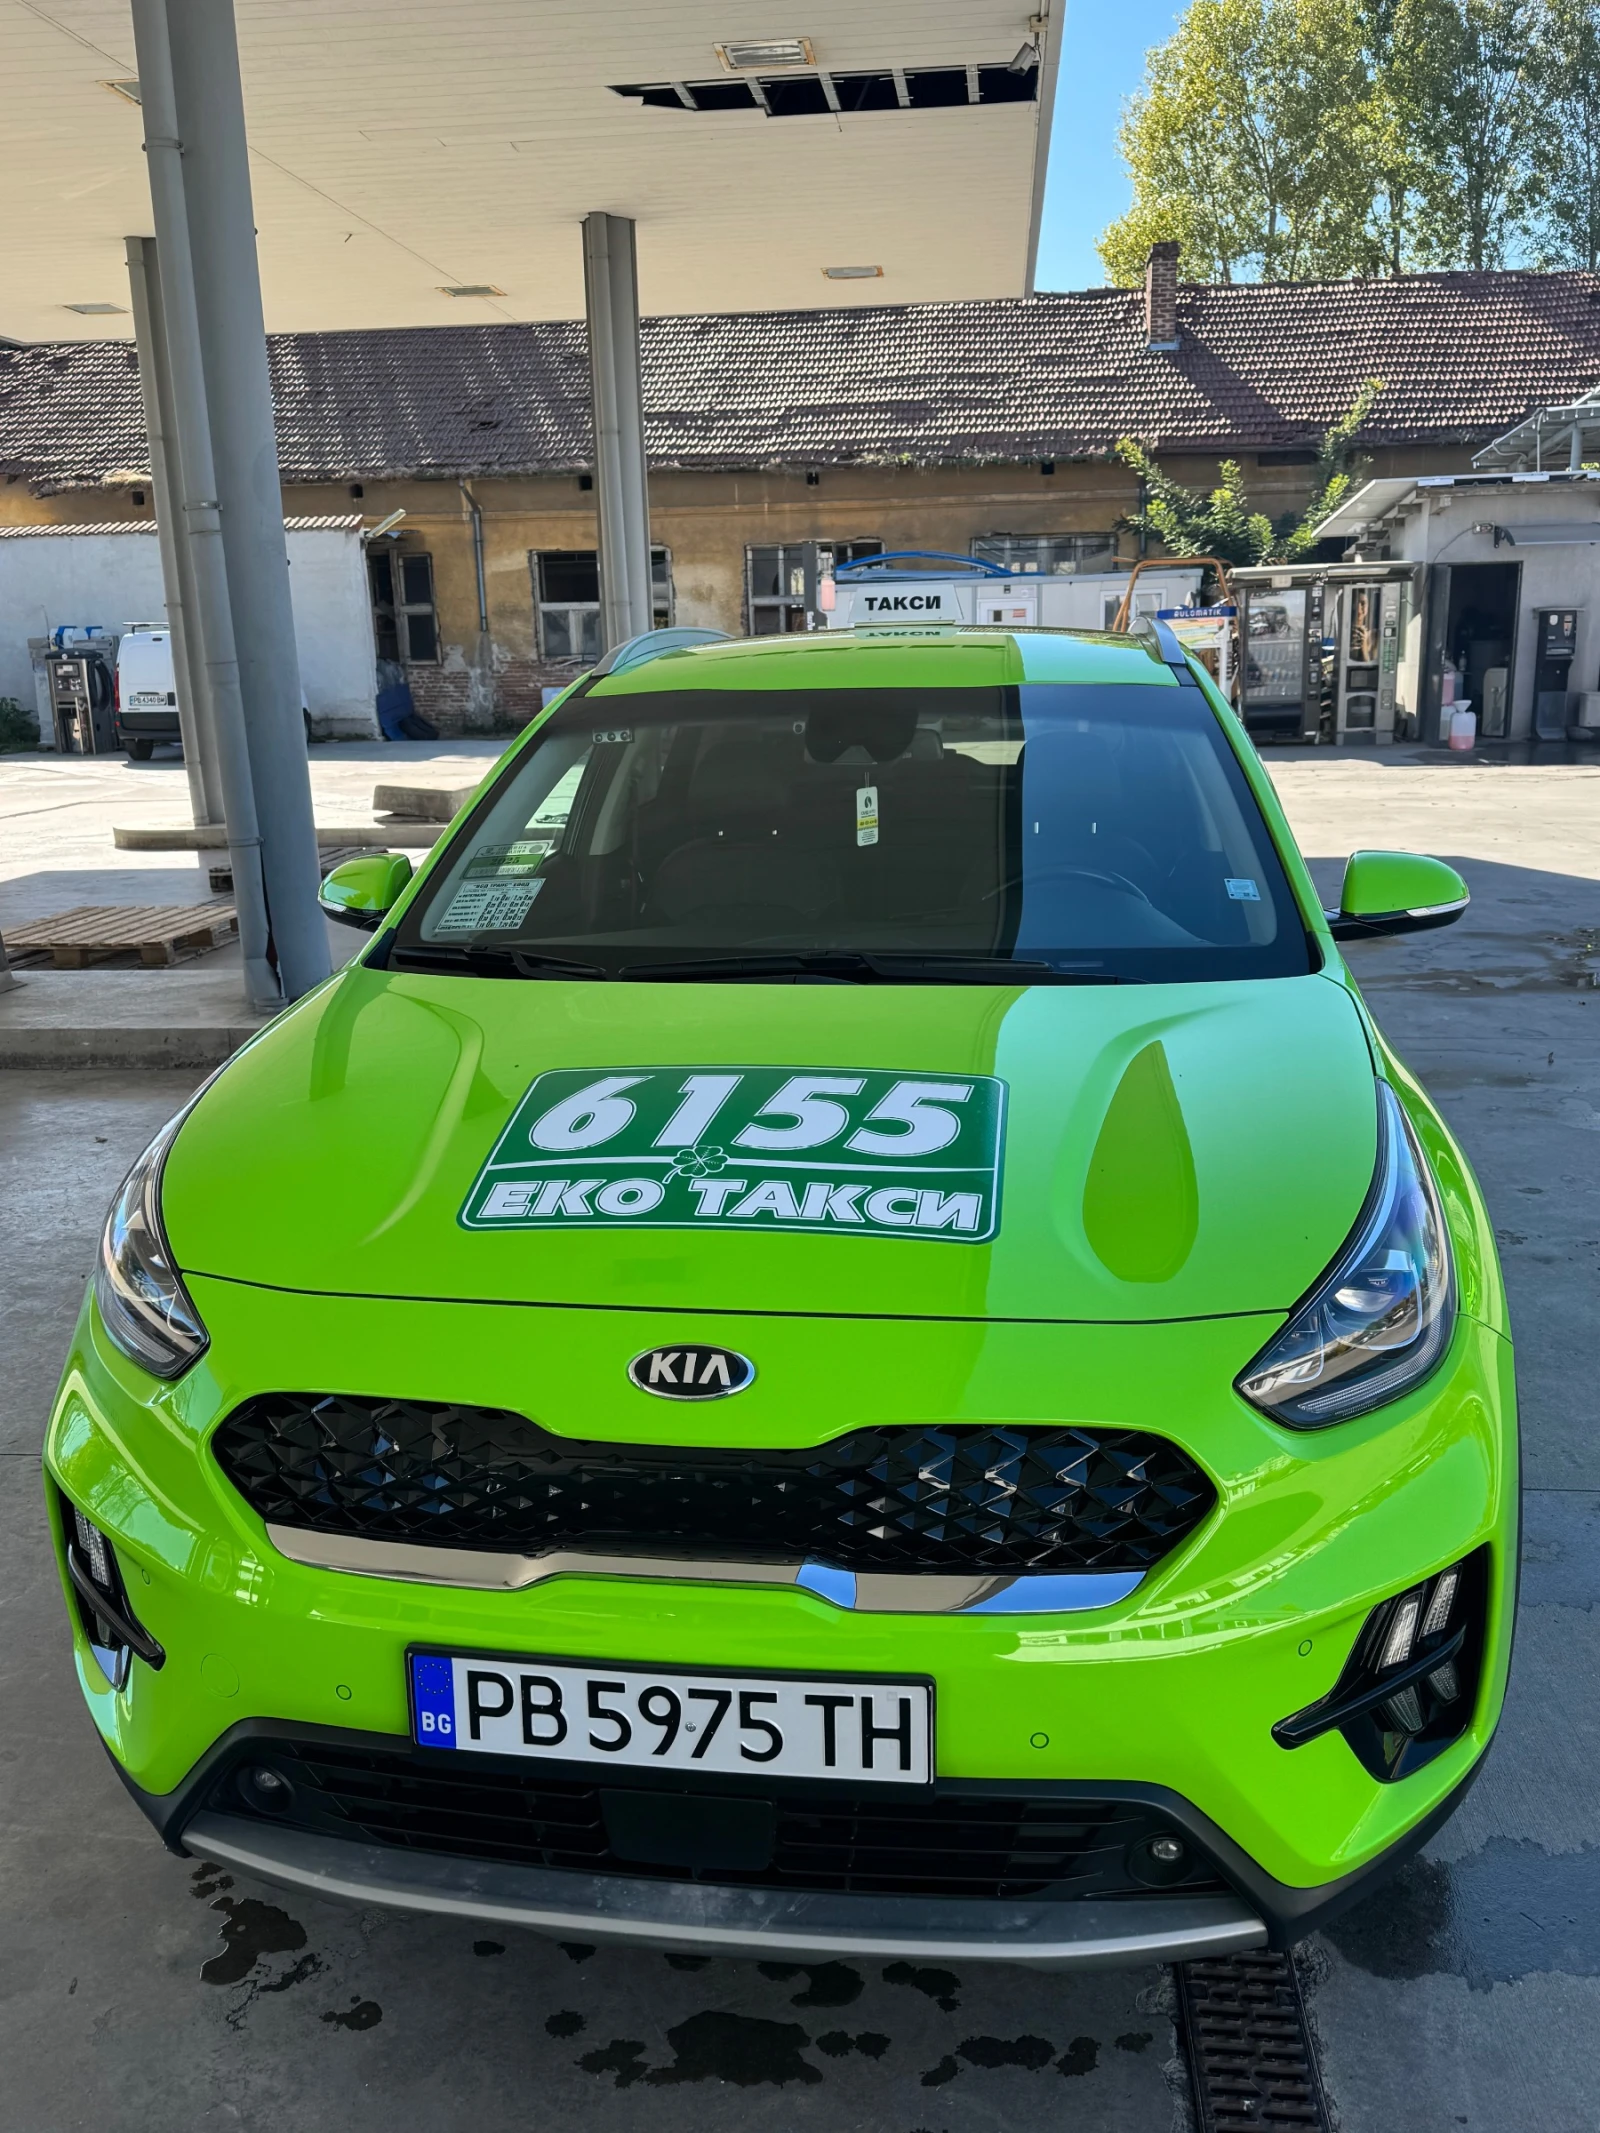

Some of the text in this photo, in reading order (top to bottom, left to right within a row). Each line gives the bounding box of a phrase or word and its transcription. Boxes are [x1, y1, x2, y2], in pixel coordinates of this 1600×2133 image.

[865, 596, 941, 611] ТАКСИ
[529, 1075, 974, 1156] 6155
[477, 1178, 983, 1231] ЕКО ТАКСИ
[648, 1352, 732, 1386] KIA
[421, 1711, 452, 1735] BG
[466, 1669, 913, 1772] PB 5975 TH
